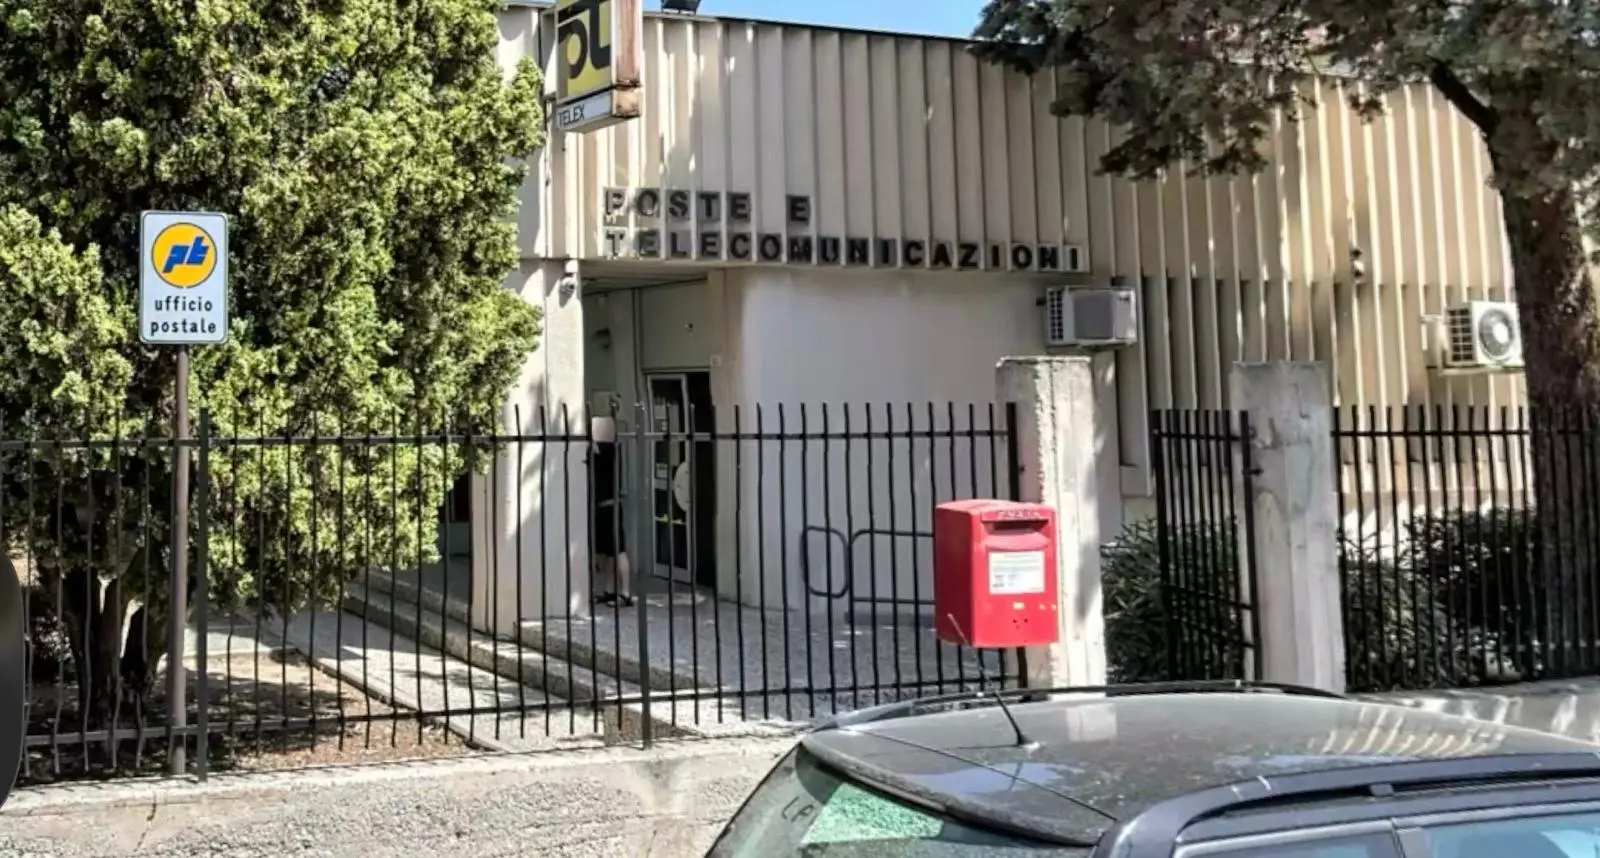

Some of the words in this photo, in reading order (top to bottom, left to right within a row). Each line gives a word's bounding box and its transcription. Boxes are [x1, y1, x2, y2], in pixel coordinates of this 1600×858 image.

[557, 103, 585, 127] TELEX
[605, 189, 749, 219] POSTE
[790, 195, 811, 222] E
[606, 230, 1079, 270] TELECOMUNICAZIONI
[154, 296, 213, 312] ufficio
[150, 318, 217, 336] postale
